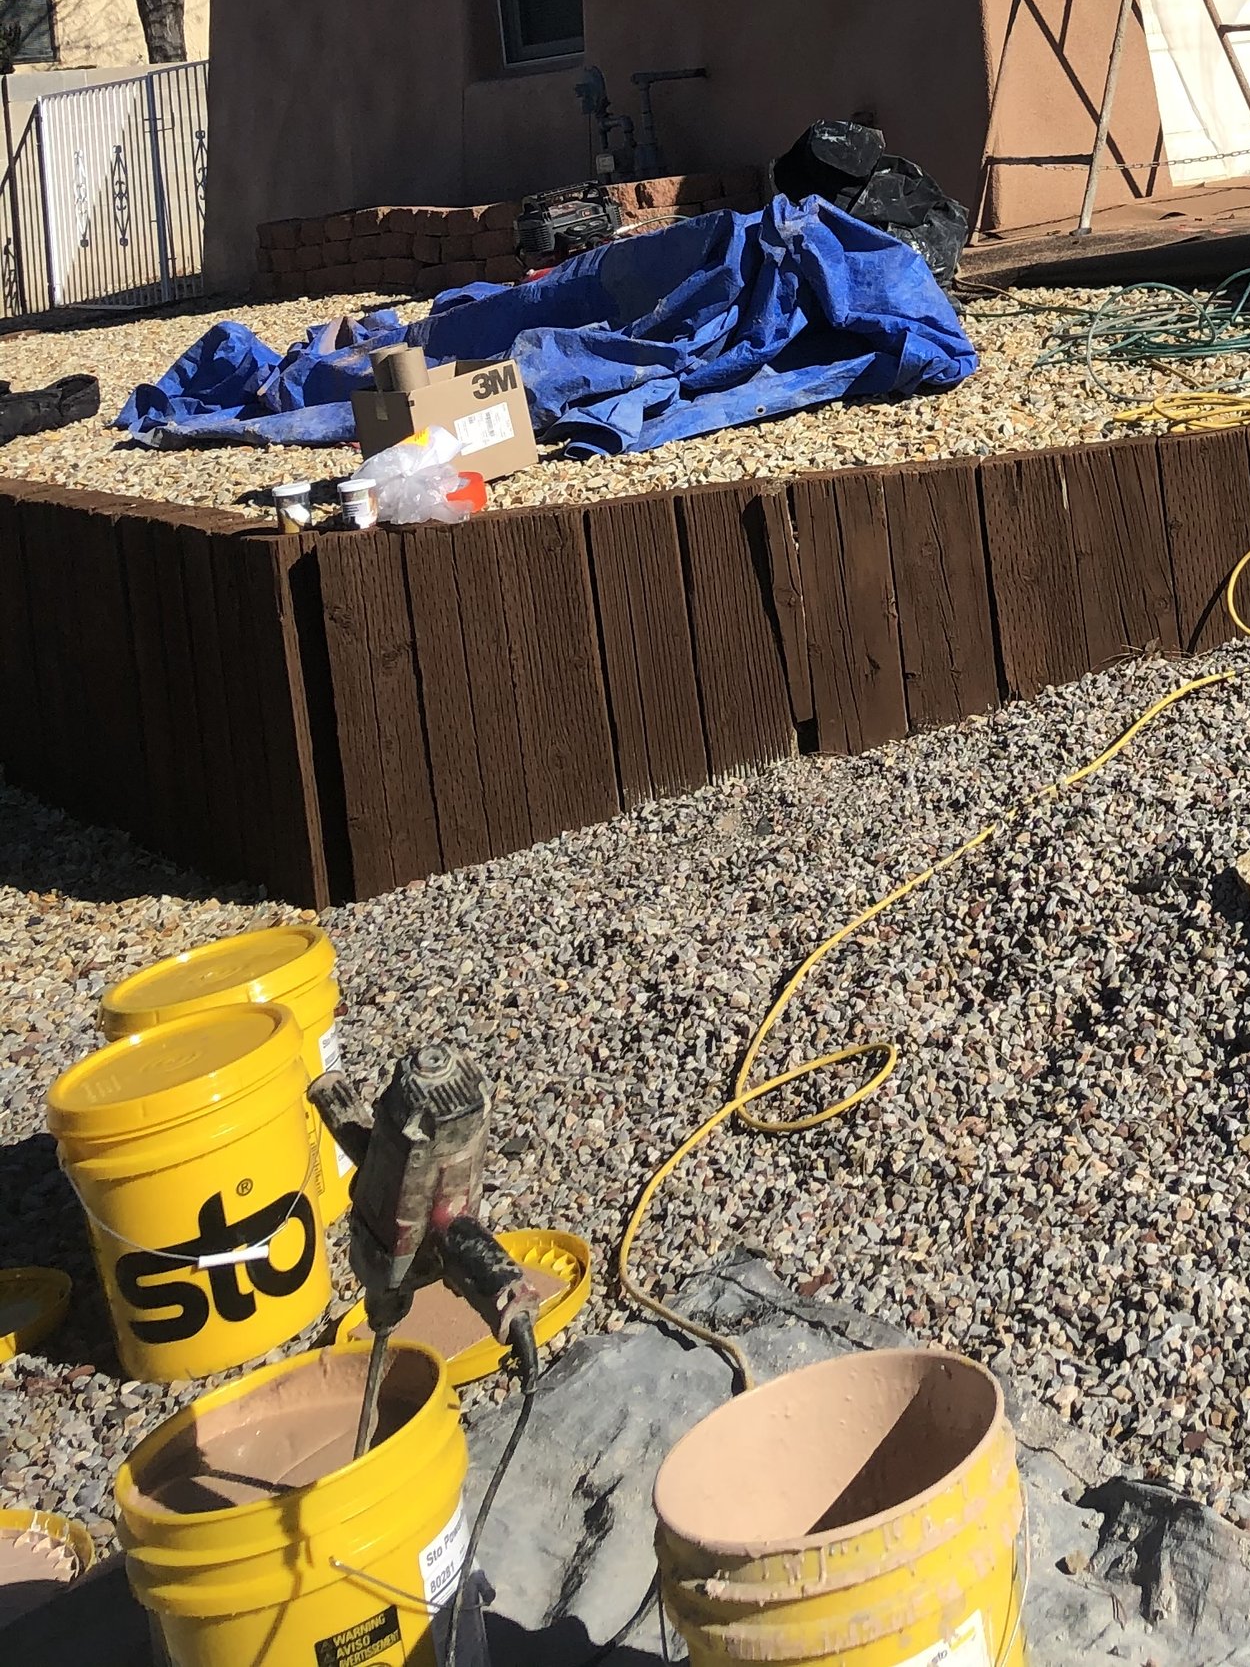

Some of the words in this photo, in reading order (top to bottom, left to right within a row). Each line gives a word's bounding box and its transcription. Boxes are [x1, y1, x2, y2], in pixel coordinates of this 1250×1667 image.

[471, 364, 518, 400] 3M
[115, 1190, 316, 1345] sto
[426, 1546, 443, 1567] Sto
[430, 1561, 455, 1594] 80281
[333, 1613, 386, 1647] WARNING
[336, 1635, 371, 1660] AVISO
